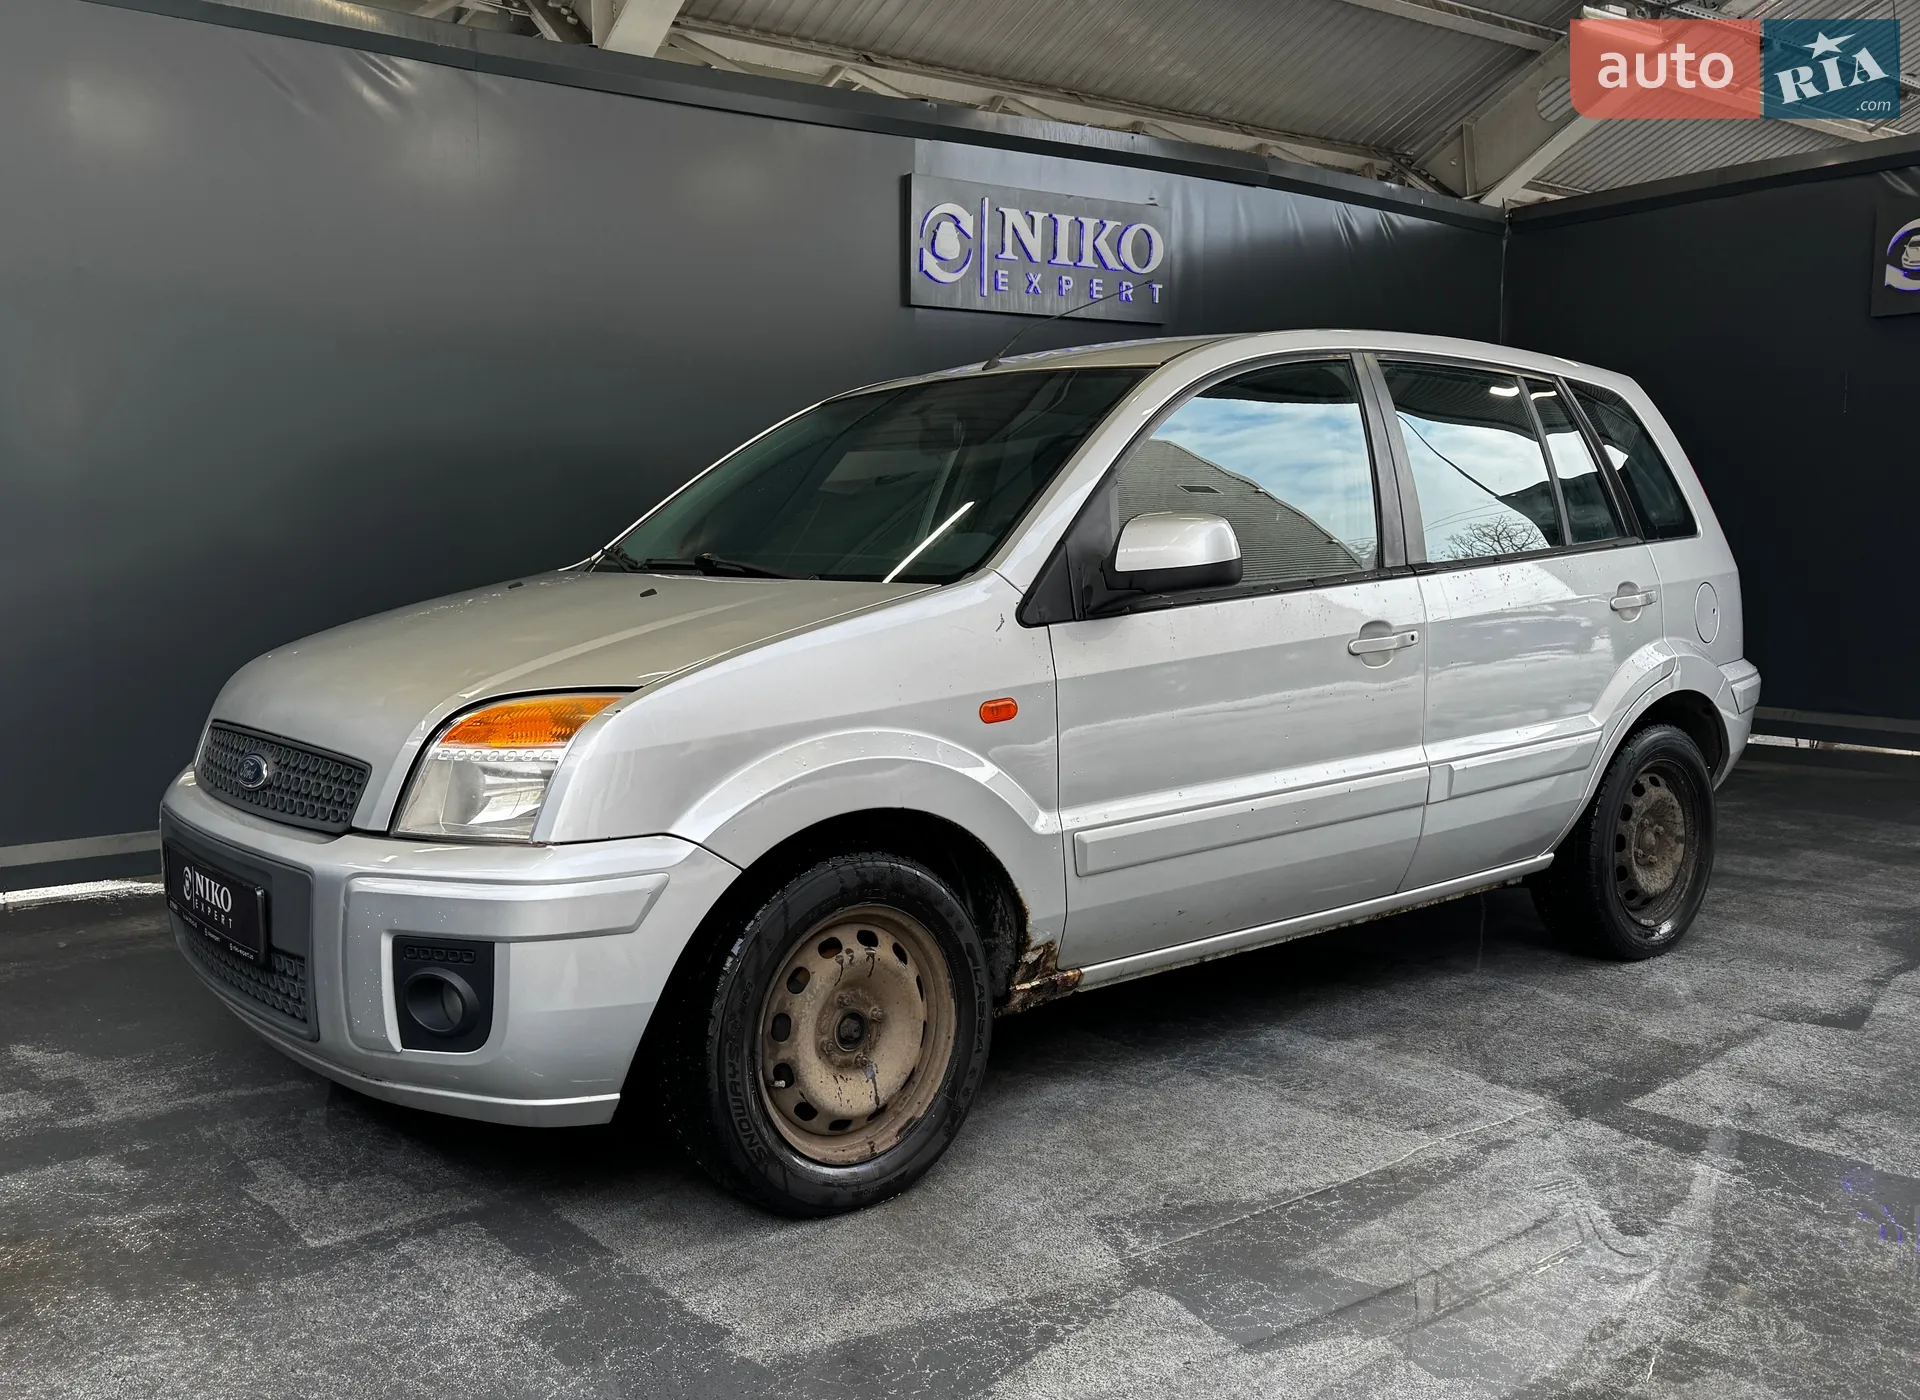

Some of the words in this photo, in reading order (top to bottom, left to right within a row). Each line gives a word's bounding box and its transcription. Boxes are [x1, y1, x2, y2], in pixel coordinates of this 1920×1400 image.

[995, 207, 1164, 275] NIKO
[994, 269, 1163, 304] EXPERT
[240, 760, 258, 780] Ford
[194, 870, 232, 912] NIKO
[195, 898, 233, 928] EXPERT
[972, 966, 987, 1054] LASSA
[727, 1041, 768, 1161] SNOWAYS
